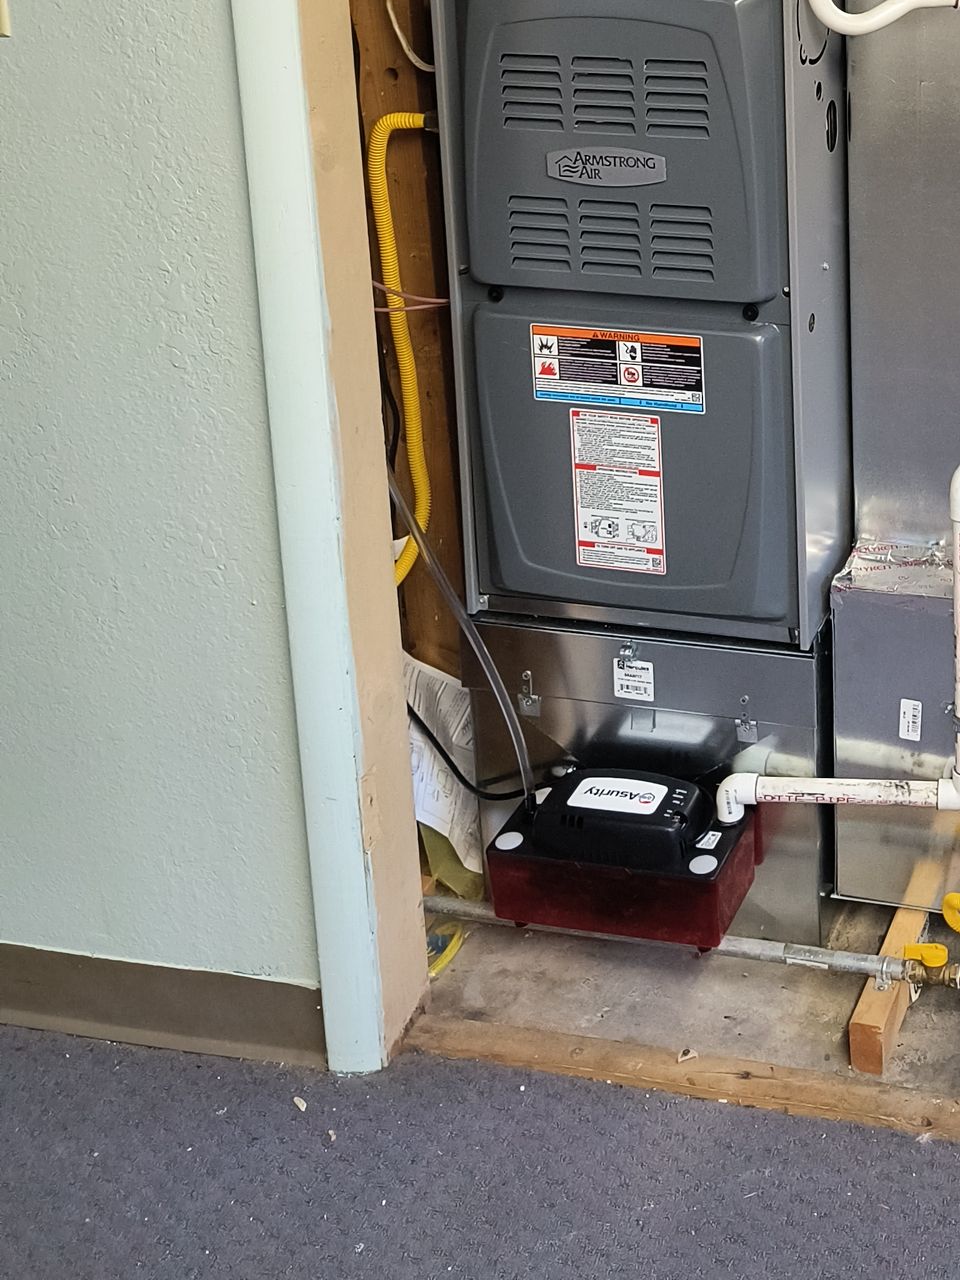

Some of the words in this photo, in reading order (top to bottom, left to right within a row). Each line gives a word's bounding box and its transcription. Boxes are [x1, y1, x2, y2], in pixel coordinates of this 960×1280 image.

[573, 151, 656, 169] ARMSTRONG
[578, 165, 602, 180] AIR
[600, 332, 640, 341] WARNING
[584, 786, 640, 800] Asurity
